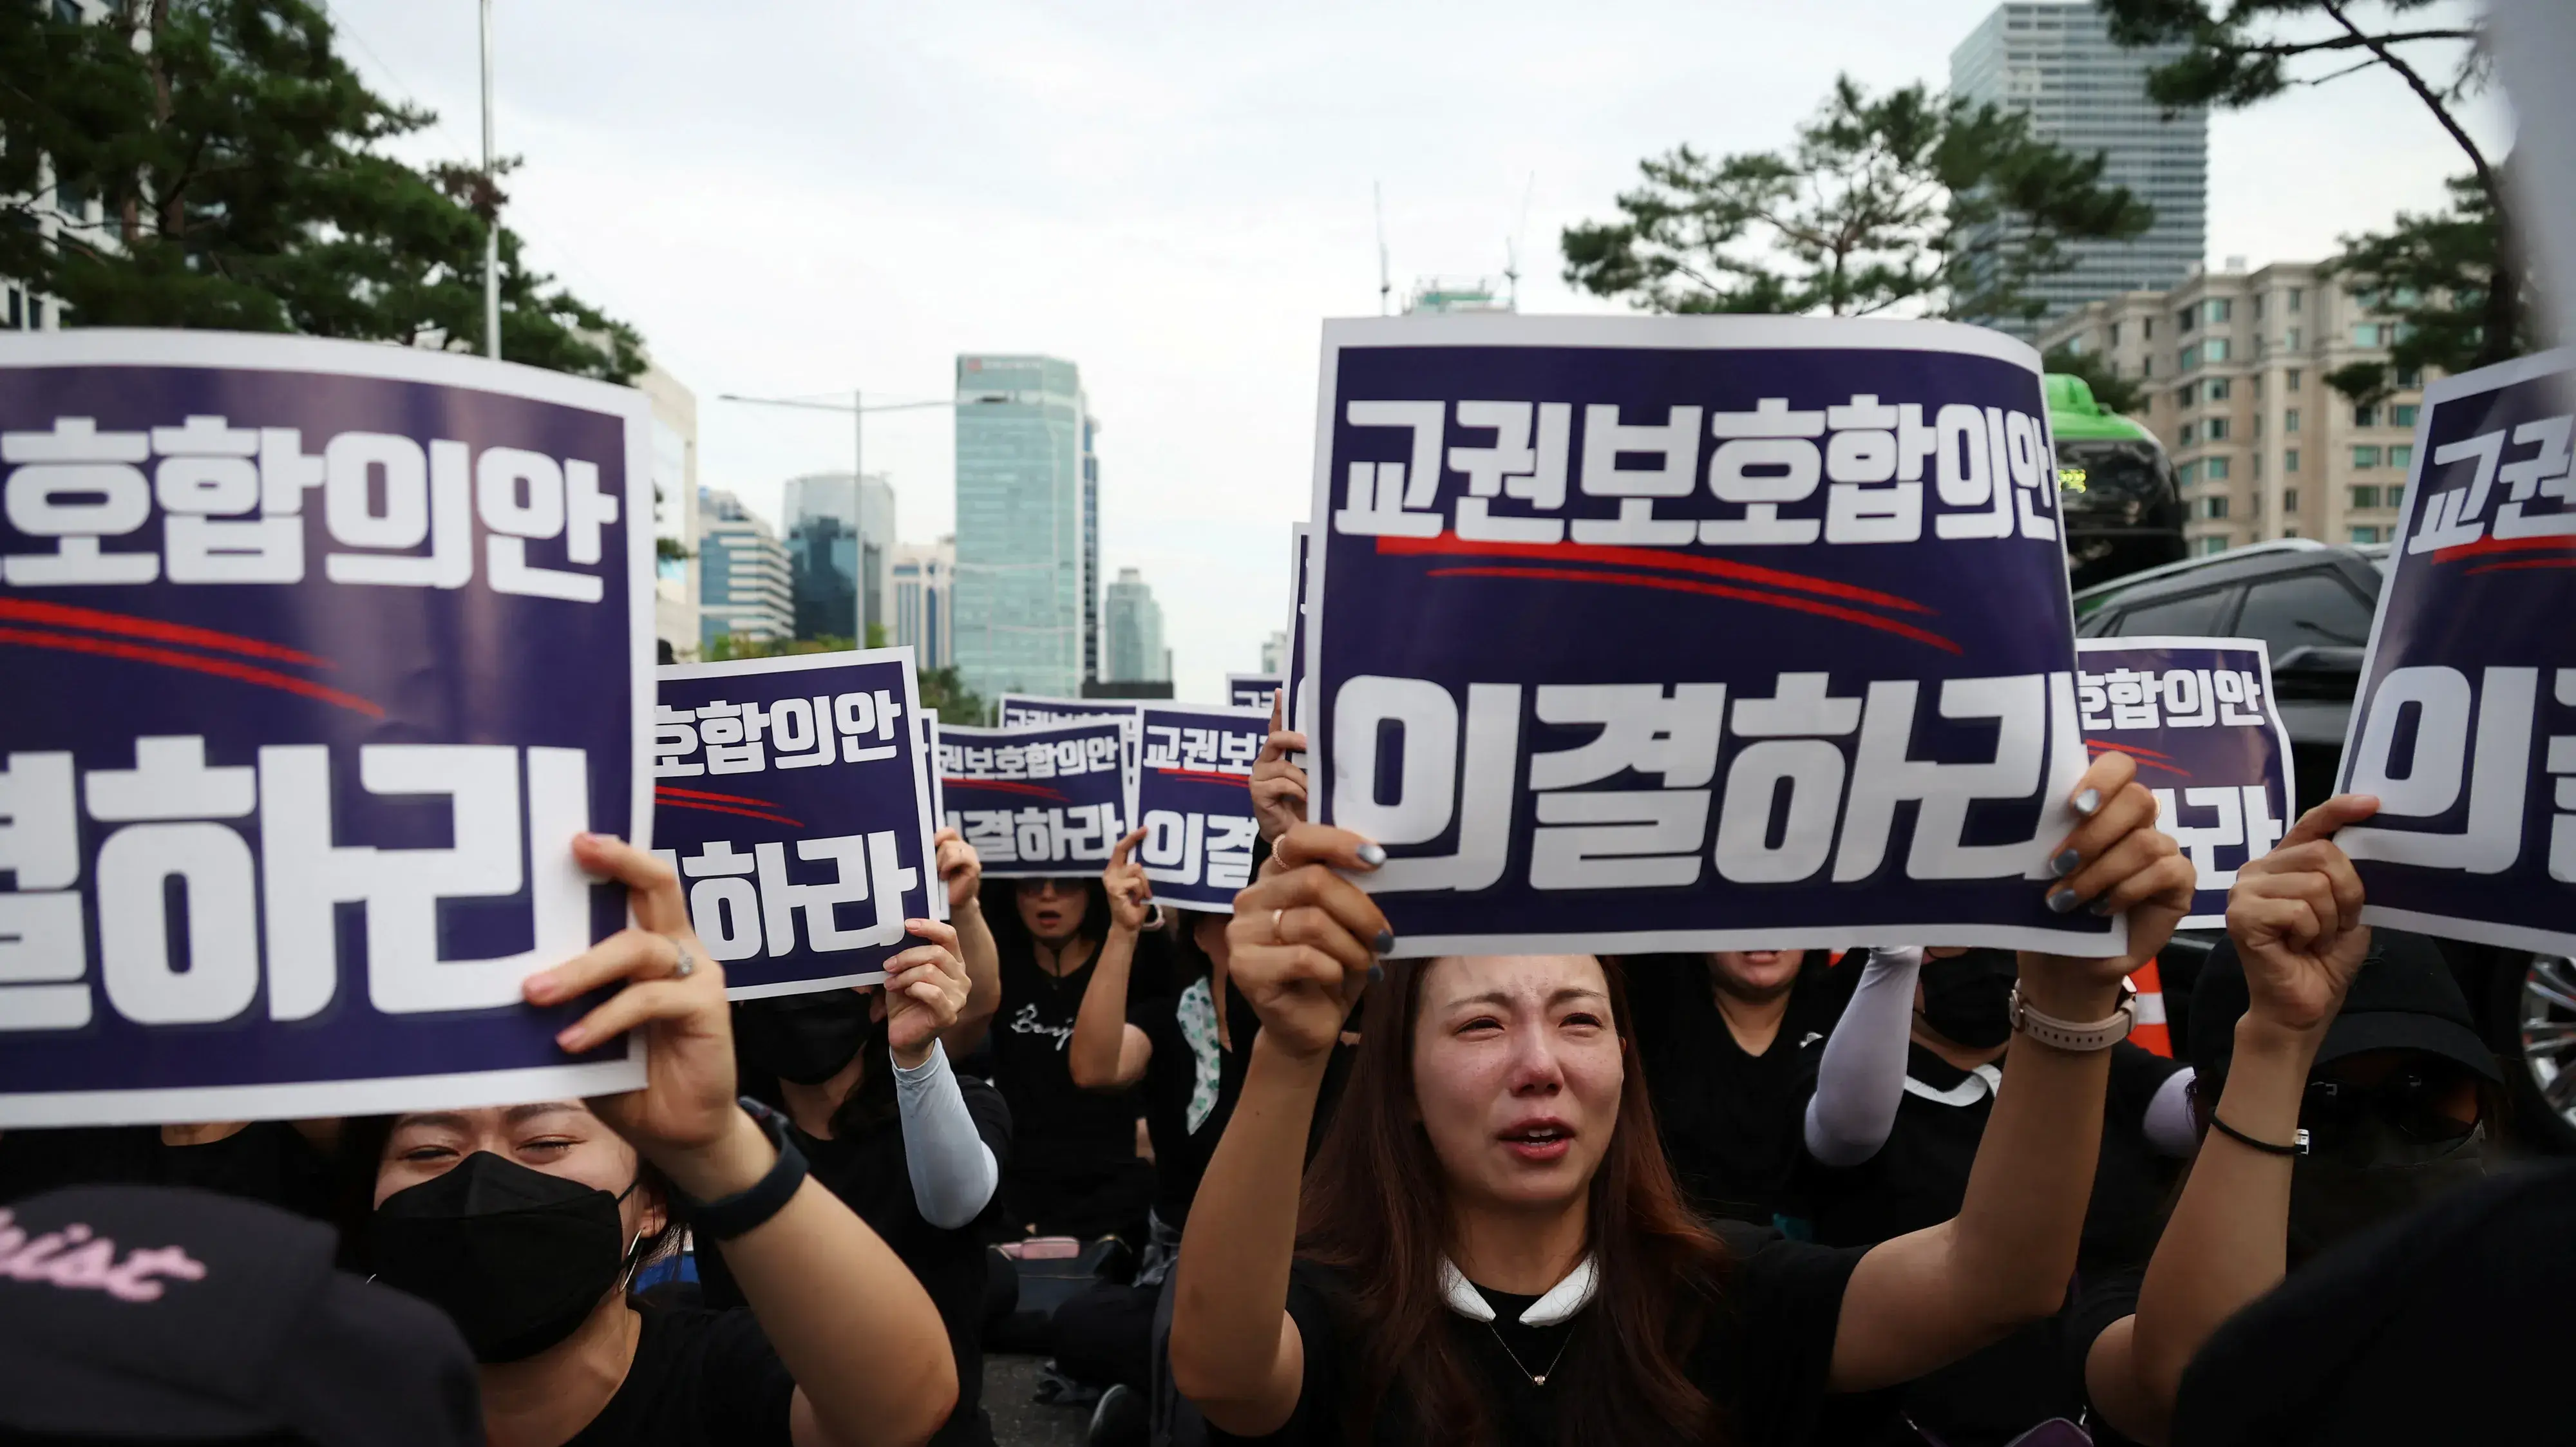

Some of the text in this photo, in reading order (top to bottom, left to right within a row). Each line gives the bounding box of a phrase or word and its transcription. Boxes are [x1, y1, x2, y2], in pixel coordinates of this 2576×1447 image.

[0, 415, 618, 603] 호합의안
[1335, 393, 2057, 545] 교권보호합의안
[1143, 725, 1267, 775] 교권보
[2332, 666, 2576, 884] 의
[652, 830, 917, 961] 하라
[945, 802, 1125, 862] 결하라
